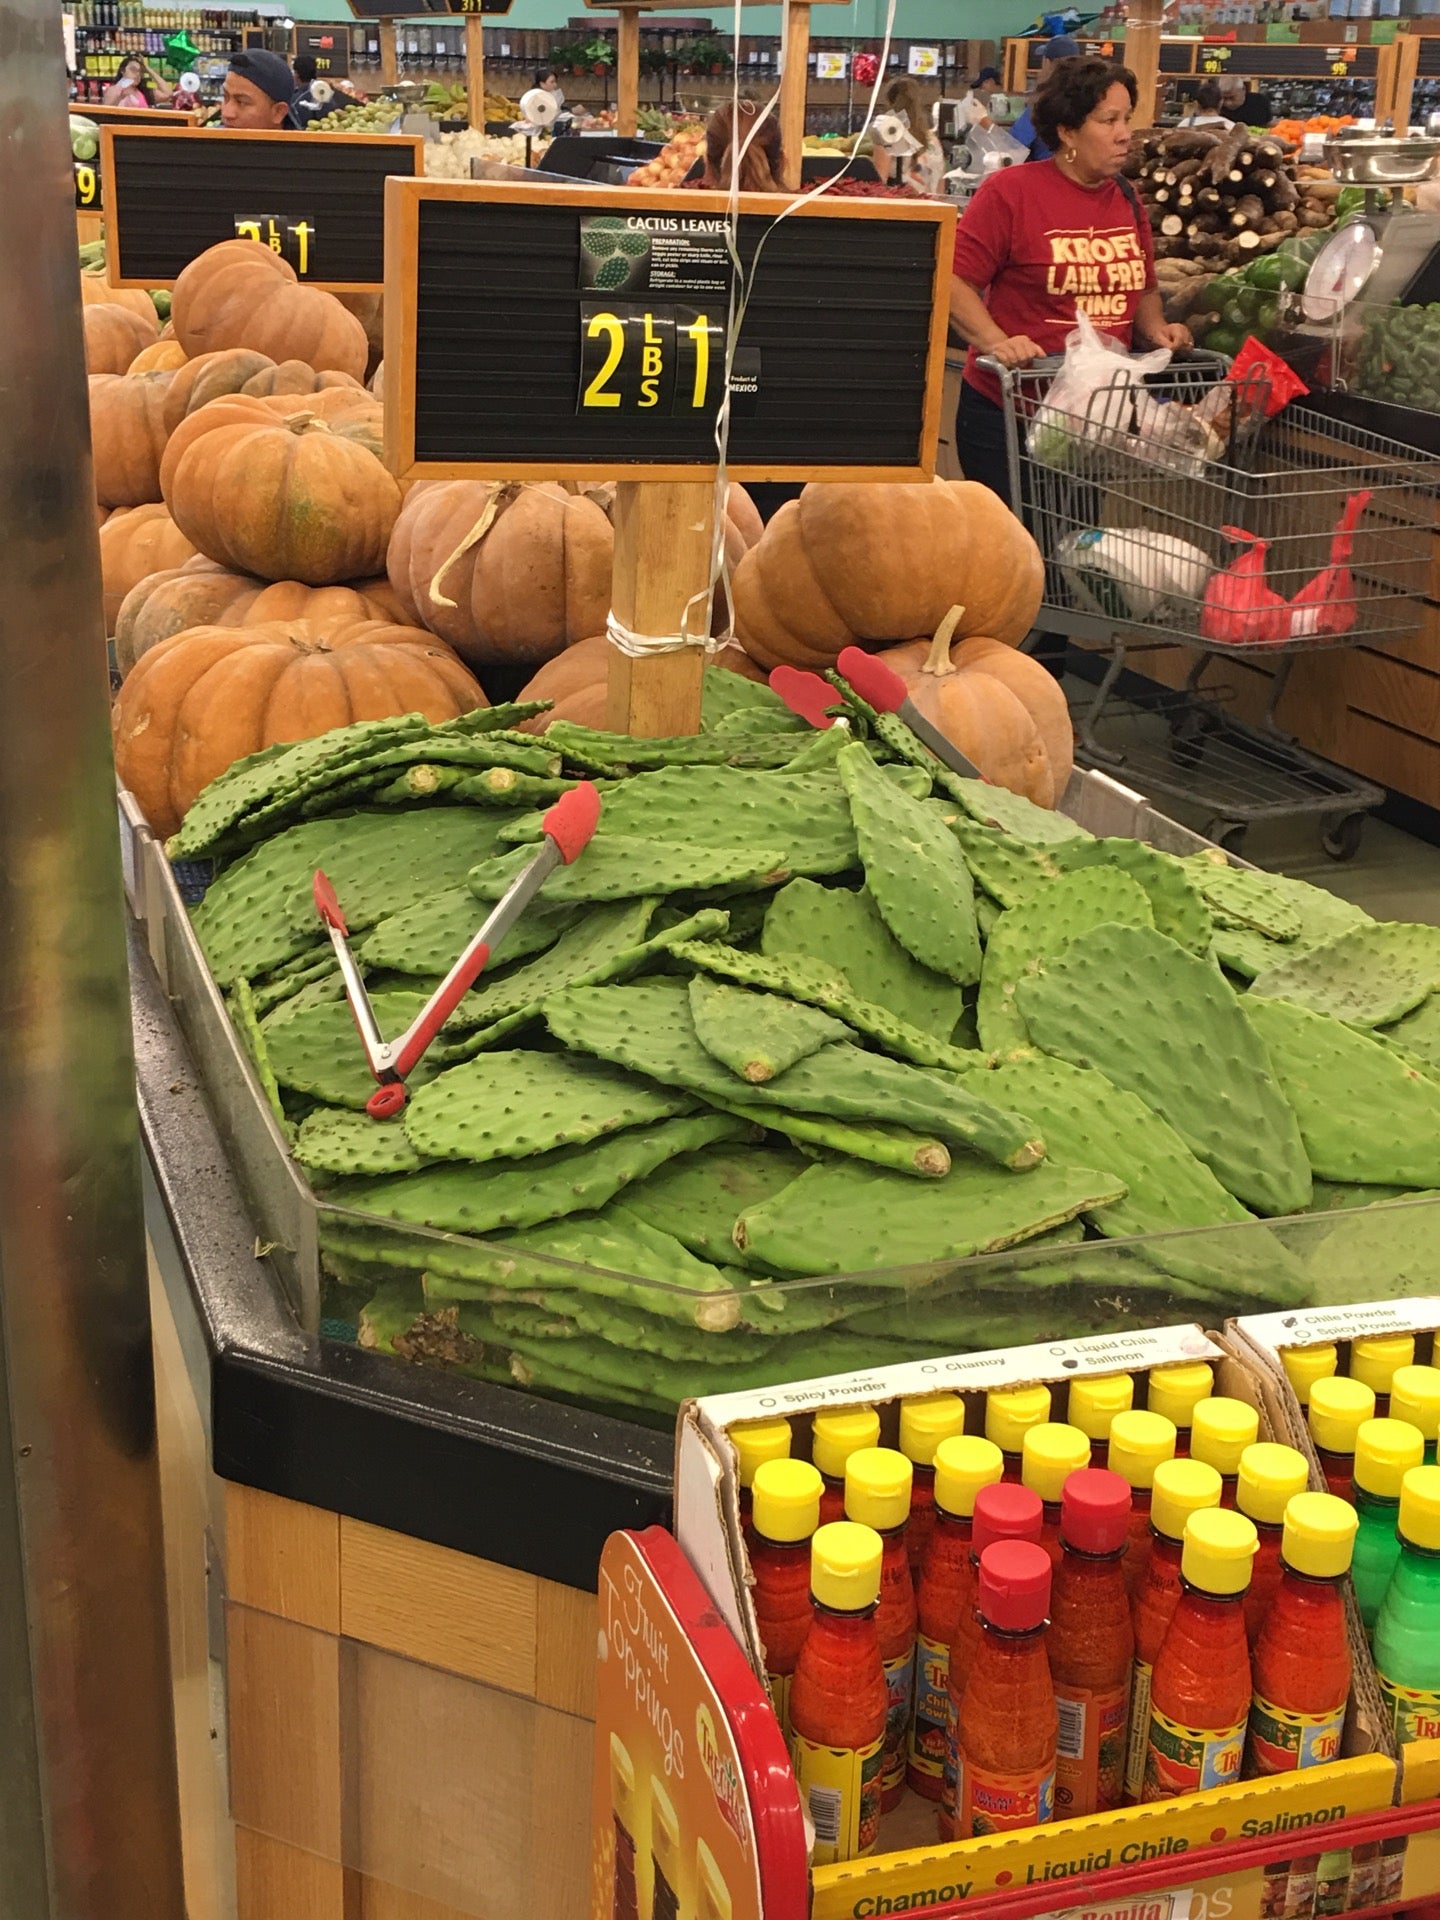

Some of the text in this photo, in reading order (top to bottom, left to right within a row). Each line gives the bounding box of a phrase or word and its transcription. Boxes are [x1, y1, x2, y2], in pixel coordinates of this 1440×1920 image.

[627, 216, 731, 233] CACTUS LEAVES
[1075, 294, 1127, 316] TING
[583, 313, 625, 407] 2
[689, 315, 709, 407] 1
[729, 384, 758, 392] MEXICO
[1304, 1309, 1397, 1324] Chile Powder
[1317, 1320, 1412, 1336] Spicy Powder
[1072, 1336, 1158, 1354] Liquid Chile
[945, 1356, 1006, 1373] Chamoy
[784, 1381, 888, 1405] Spicy Powder
[624, 1564, 669, 1684] Fruit
[602, 1567, 684, 1779] Toppings
[1026, 1849, 1112, 1885] Liquid
[1120, 1836, 1189, 1864] Chile
[1240, 1805, 1346, 1838] Salimon
